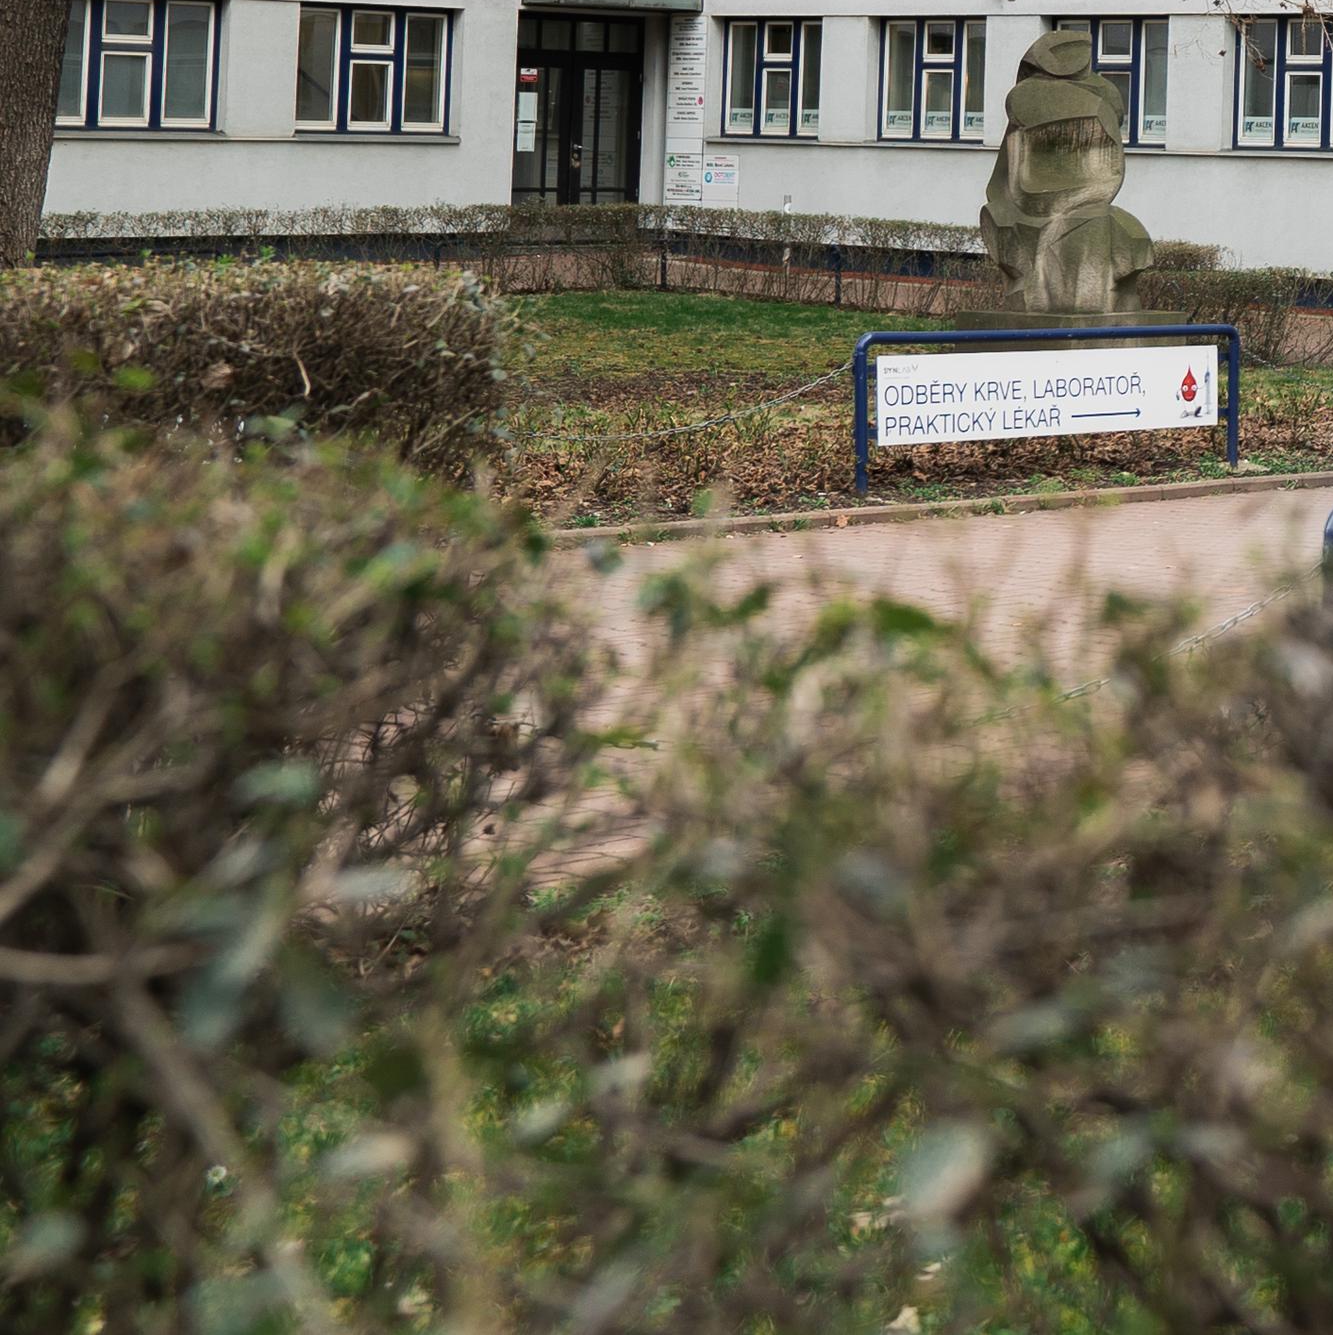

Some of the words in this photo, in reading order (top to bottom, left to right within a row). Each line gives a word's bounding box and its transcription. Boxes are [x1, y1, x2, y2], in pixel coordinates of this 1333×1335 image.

[884, 379, 968, 407] ODBĚRY
[974, 380, 1027, 403] KRVE,
[1033, 372, 1146, 399] LABORATOŘ,
[885, 407, 997, 437] PRAKTICKÝ
[1003, 405, 1061, 430] LÉKAŘ
